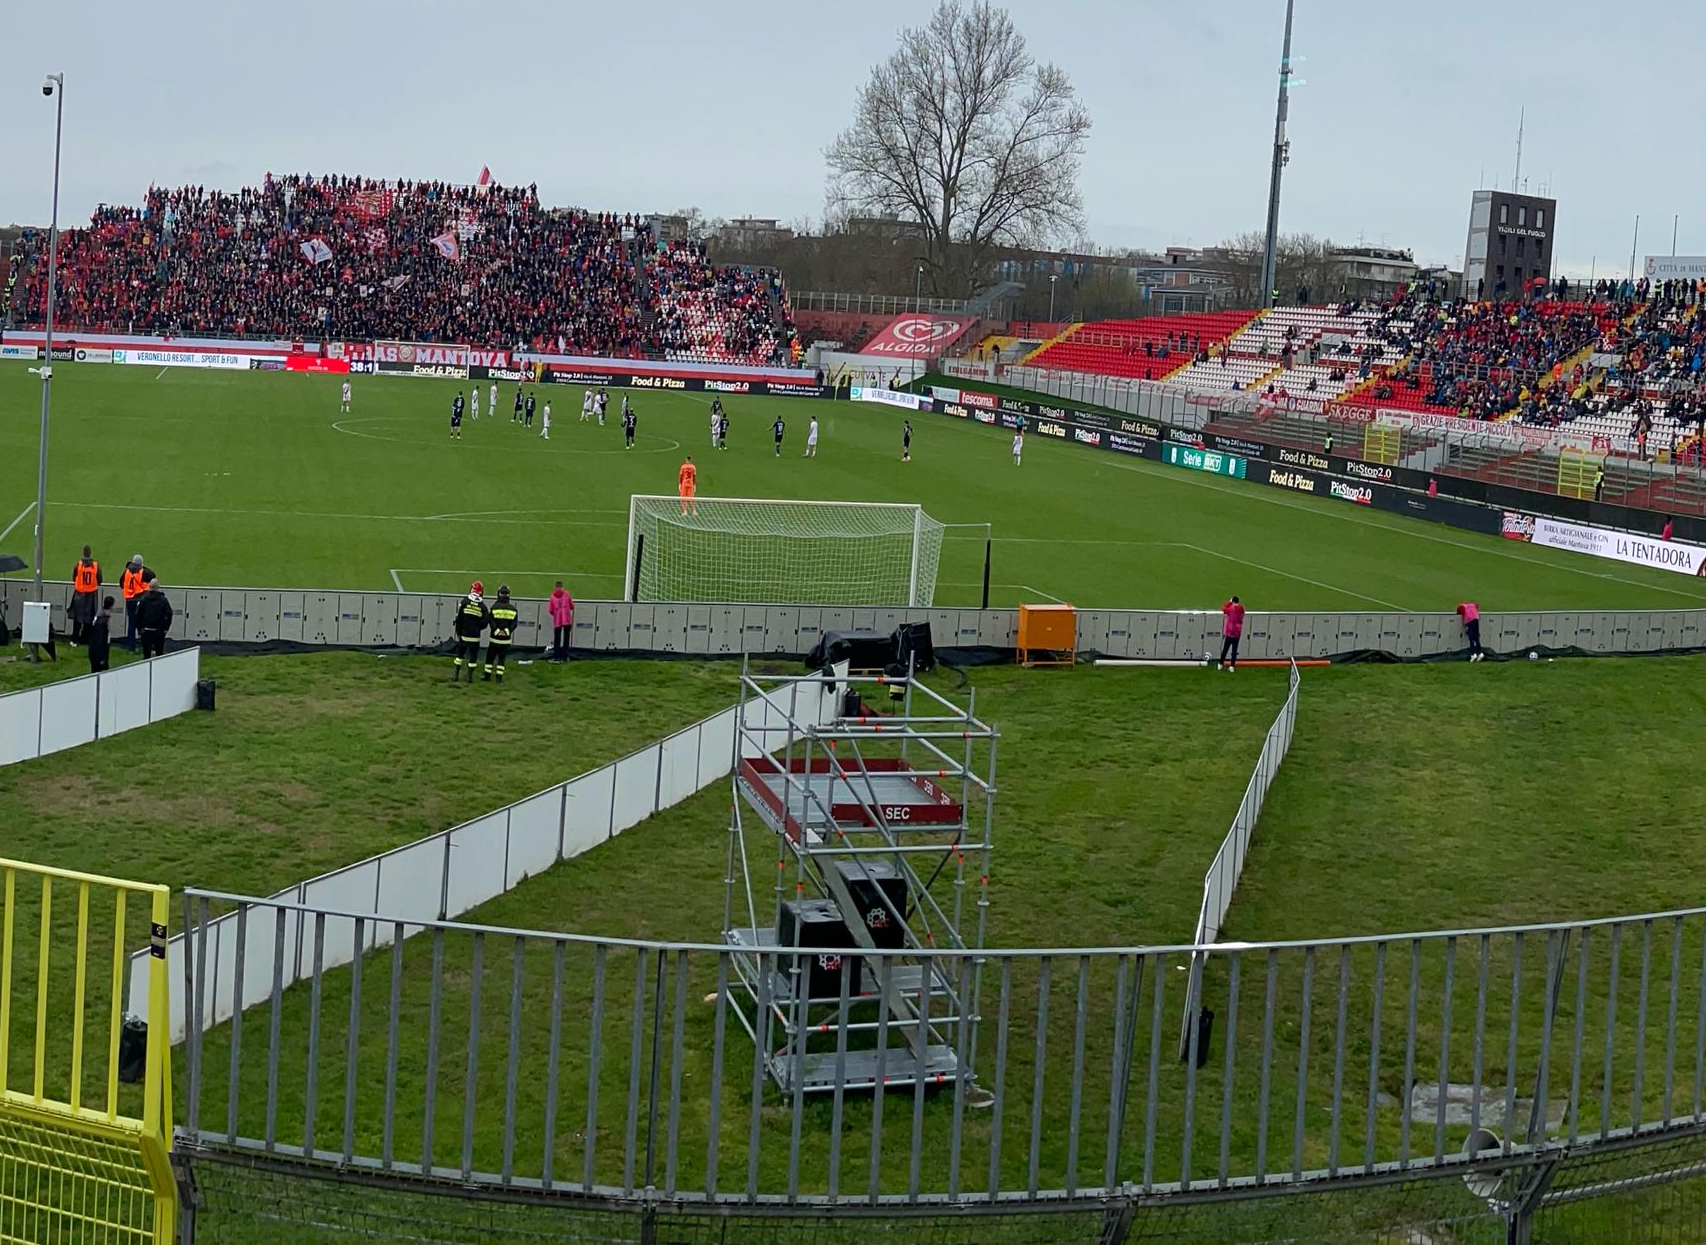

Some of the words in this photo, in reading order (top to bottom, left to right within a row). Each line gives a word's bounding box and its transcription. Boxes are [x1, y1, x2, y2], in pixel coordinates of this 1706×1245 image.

[871, 342, 936, 354] ALGIDA
[137, 352, 171, 362] VERONELLO
[201, 354, 220, 364] SPORT
[226, 356, 238, 365] FUN
[415, 347, 508, 368] MANTOVA
[413, 365, 436, 375] Food
[436, 366, 444, 375] &
[445, 366, 467, 376] Pizza
[631, 376, 653, 387] Food
[653, 377, 661, 387] &
[662, 378, 685, 389] Pizza
[704, 380, 749, 391] PitStop2.0
[1296, 398, 1324, 414] GUARDIA
[1121, 420, 1136, 432] Food
[1136, 422, 1141, 432] &
[1141, 423, 1158, 436] Pizza
[1420, 415, 1443, 427] GRAZIE
[1445, 418, 1484, 433] PRESIDENTE
[1170, 429, 1203, 442] PitStop2.0
[1183, 450, 1202, 467] Serie
[1279, 449, 1299, 462] Food
[1299, 453, 1306, 464] &
[1307, 454, 1329, 469] Pizza
[1347, 461, 1392, 479] PitStop2.0
[1269, 470, 1287, 486] Food
[1287, 473, 1294, 487] &
[1294, 474, 1315, 491] Pizza
[1330, 481, 1372, 501] PitStop2.0
[1568, 540, 1589, 550] Mantova
[1590, 543, 1602, 553] 1911
[1616, 539, 1628, 556] LA
[1631, 541, 1692, 569] TENTADORA
[885, 807, 910, 820] SEC
